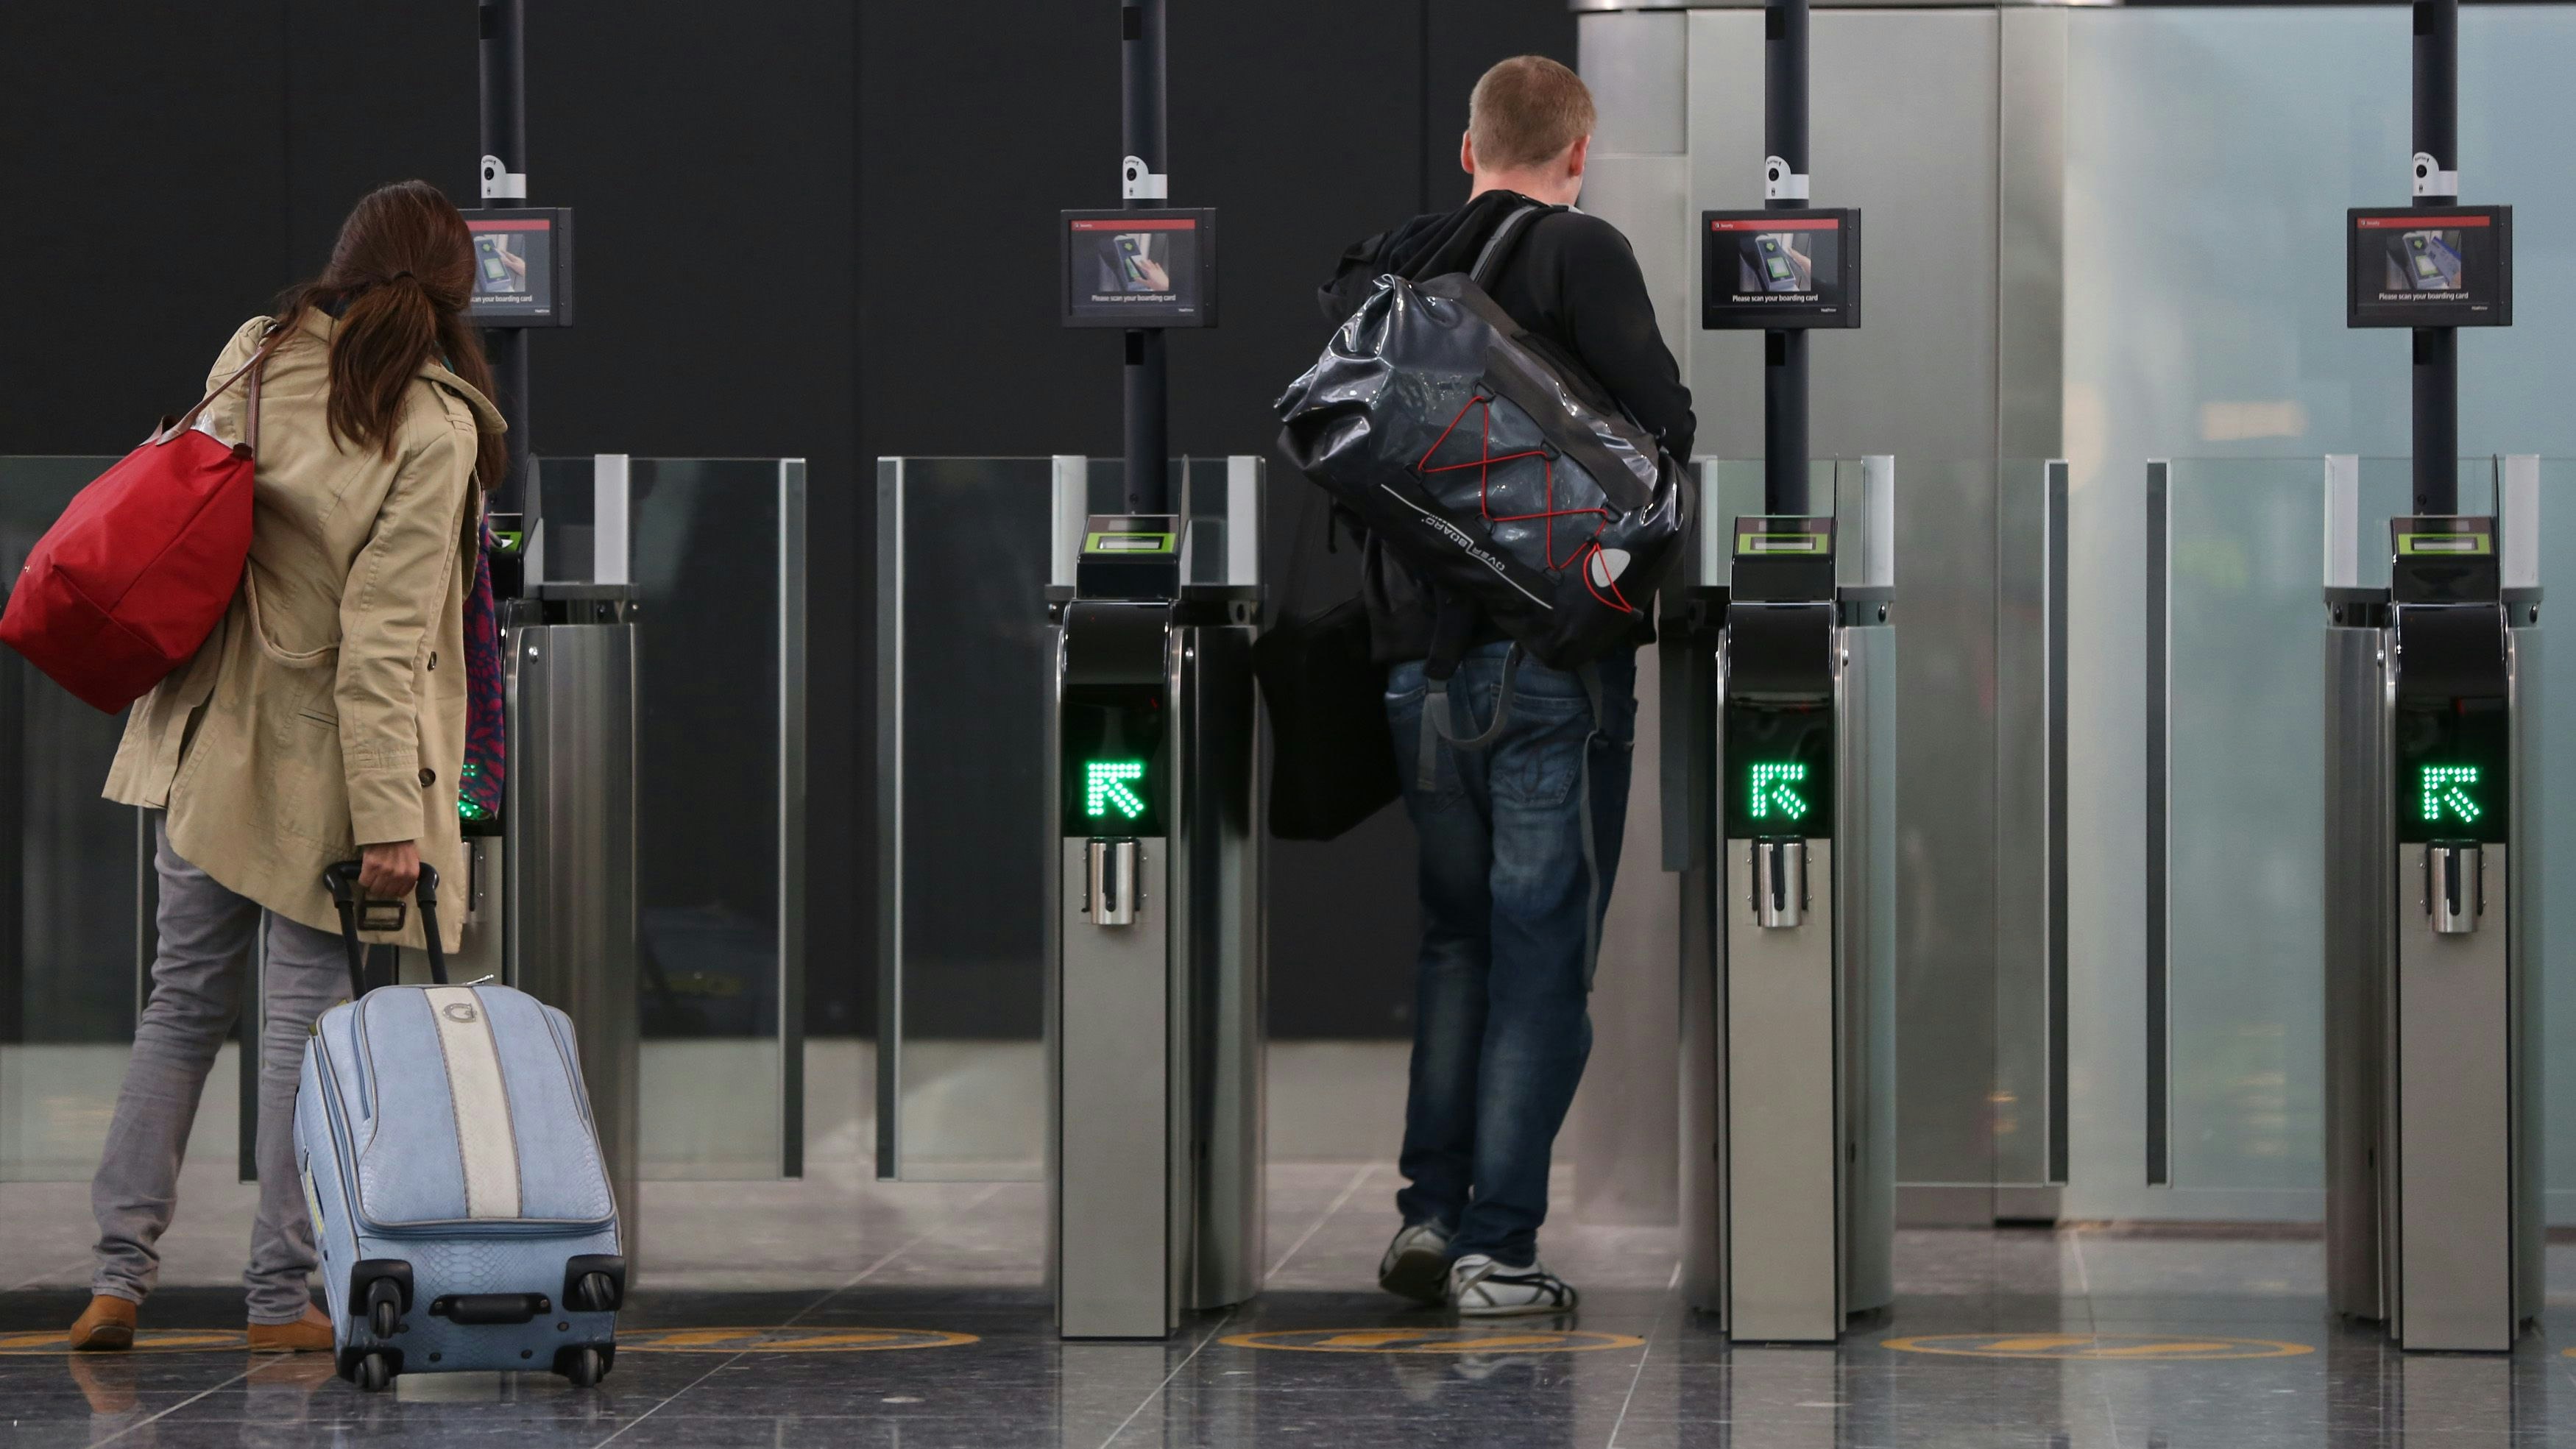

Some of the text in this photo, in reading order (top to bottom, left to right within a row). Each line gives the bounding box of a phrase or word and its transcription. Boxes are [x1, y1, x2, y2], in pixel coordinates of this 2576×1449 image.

[482, 296, 495, 304] your
[495, 294, 520, 304] boarding
[1137, 294, 1163, 302] boarding
[1765, 295, 1778, 303] your
[1779, 294, 1805, 302] boarding
[2413, 293, 2427, 301] your
[2427, 292, 2455, 300] boarding
[1472, 548, 1505, 571] OVER
